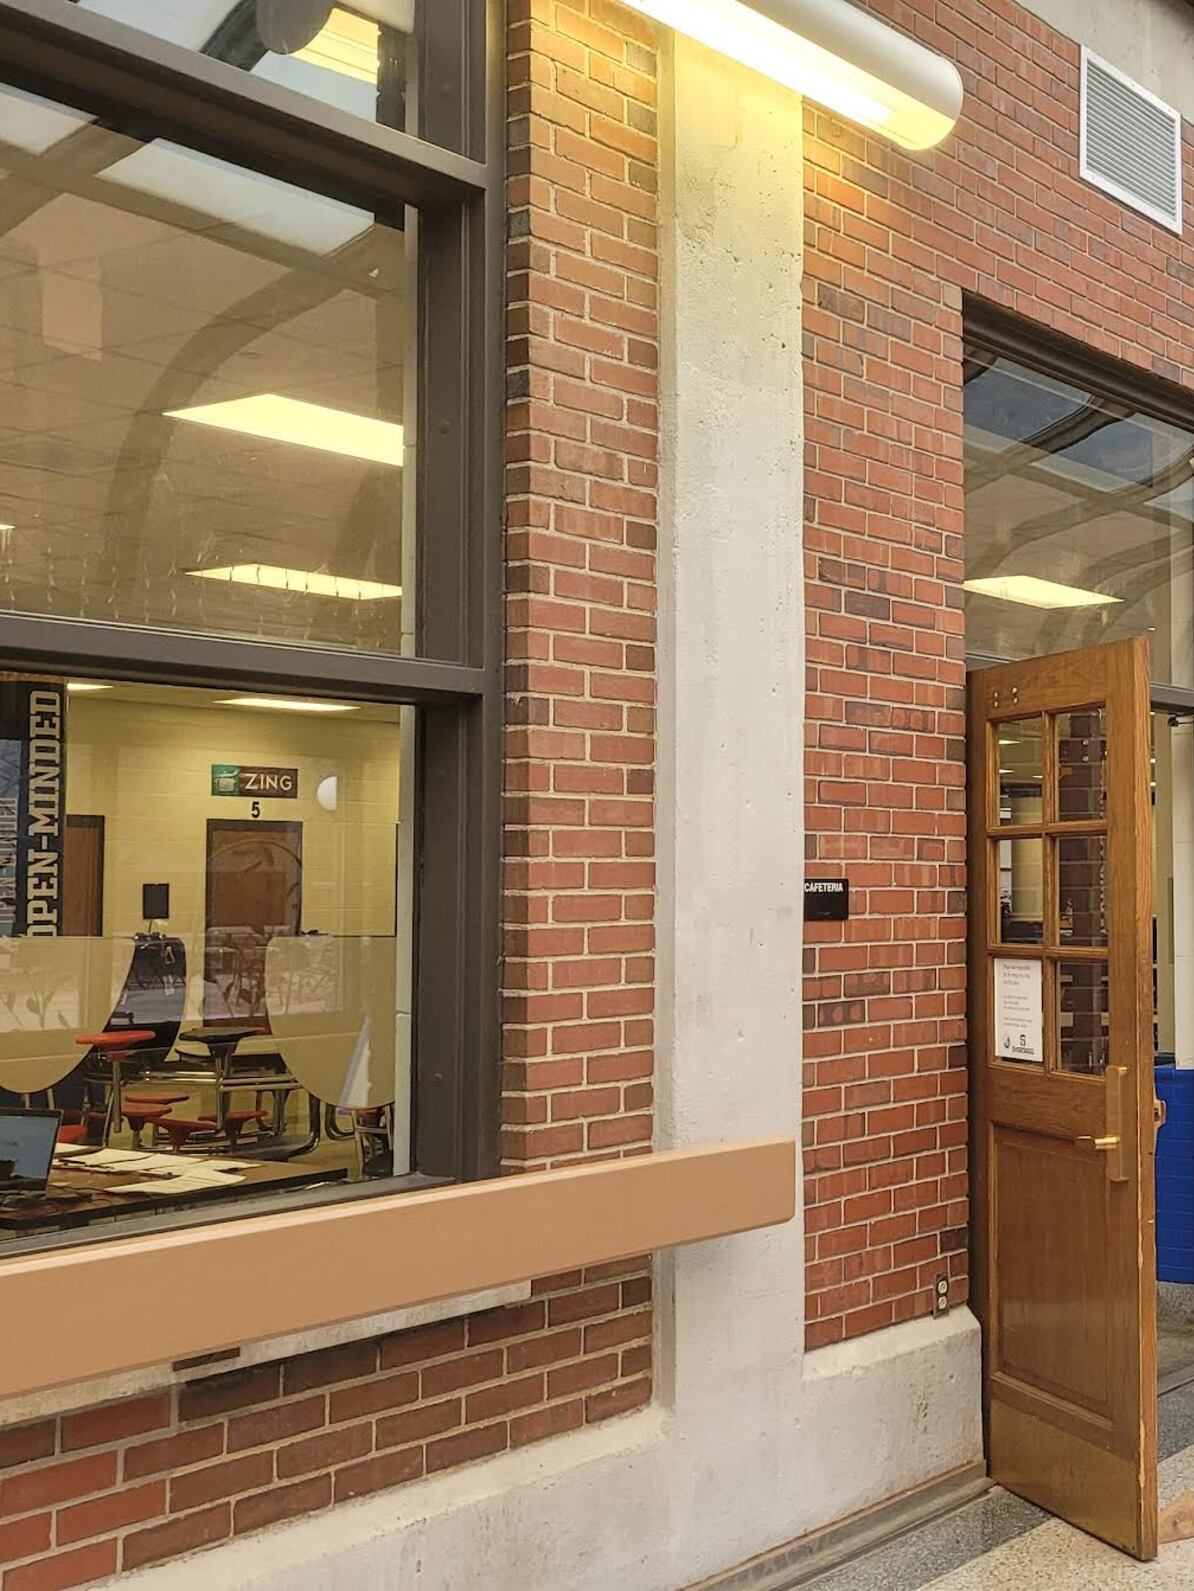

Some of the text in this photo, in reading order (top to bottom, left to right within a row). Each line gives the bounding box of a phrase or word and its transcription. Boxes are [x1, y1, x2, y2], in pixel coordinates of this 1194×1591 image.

[244, 773, 292, 791] ZING
[251, 801, 261, 818] 5
[804, 882, 844, 893] CAFETERIA
